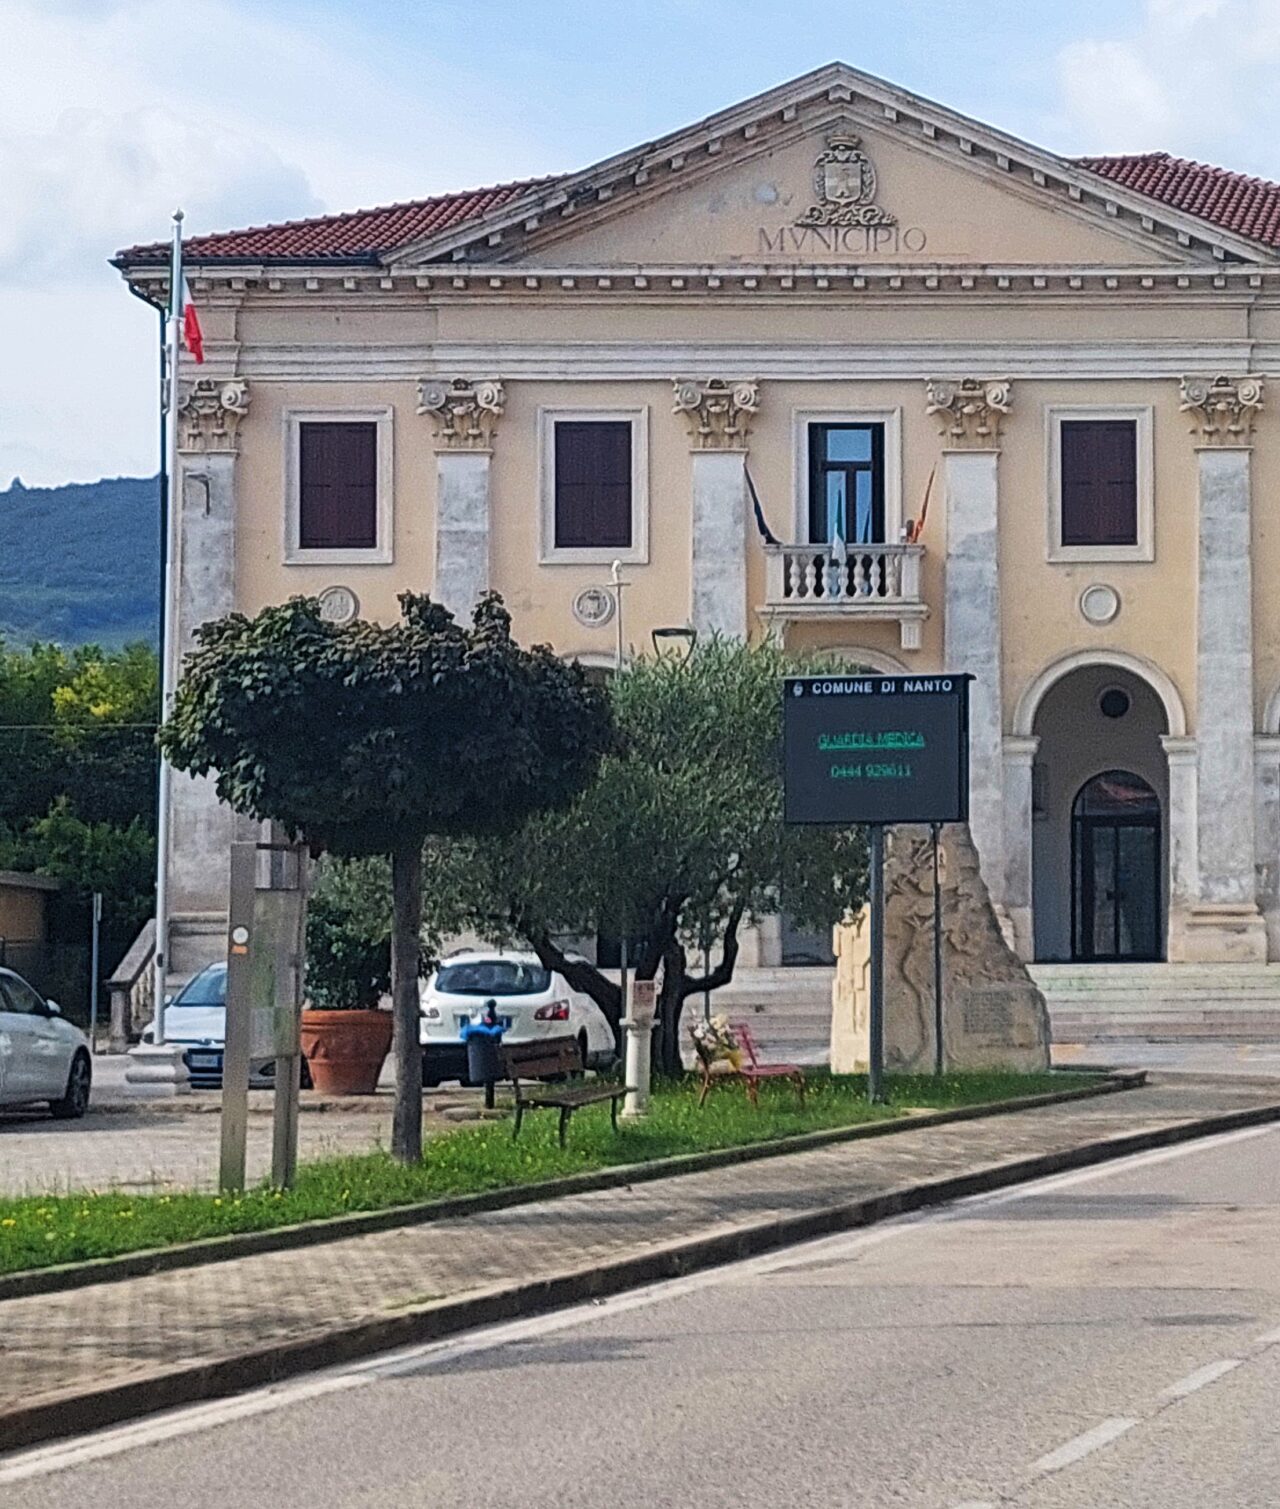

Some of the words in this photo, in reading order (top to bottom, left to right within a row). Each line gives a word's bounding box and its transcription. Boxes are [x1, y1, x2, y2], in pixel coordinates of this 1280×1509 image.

[758, 226, 927, 252] MVNICIPIO
[812, 681, 873, 695] COMUNE
[881, 680, 896, 693] DI
[903, 679, 953, 692] NANTO
